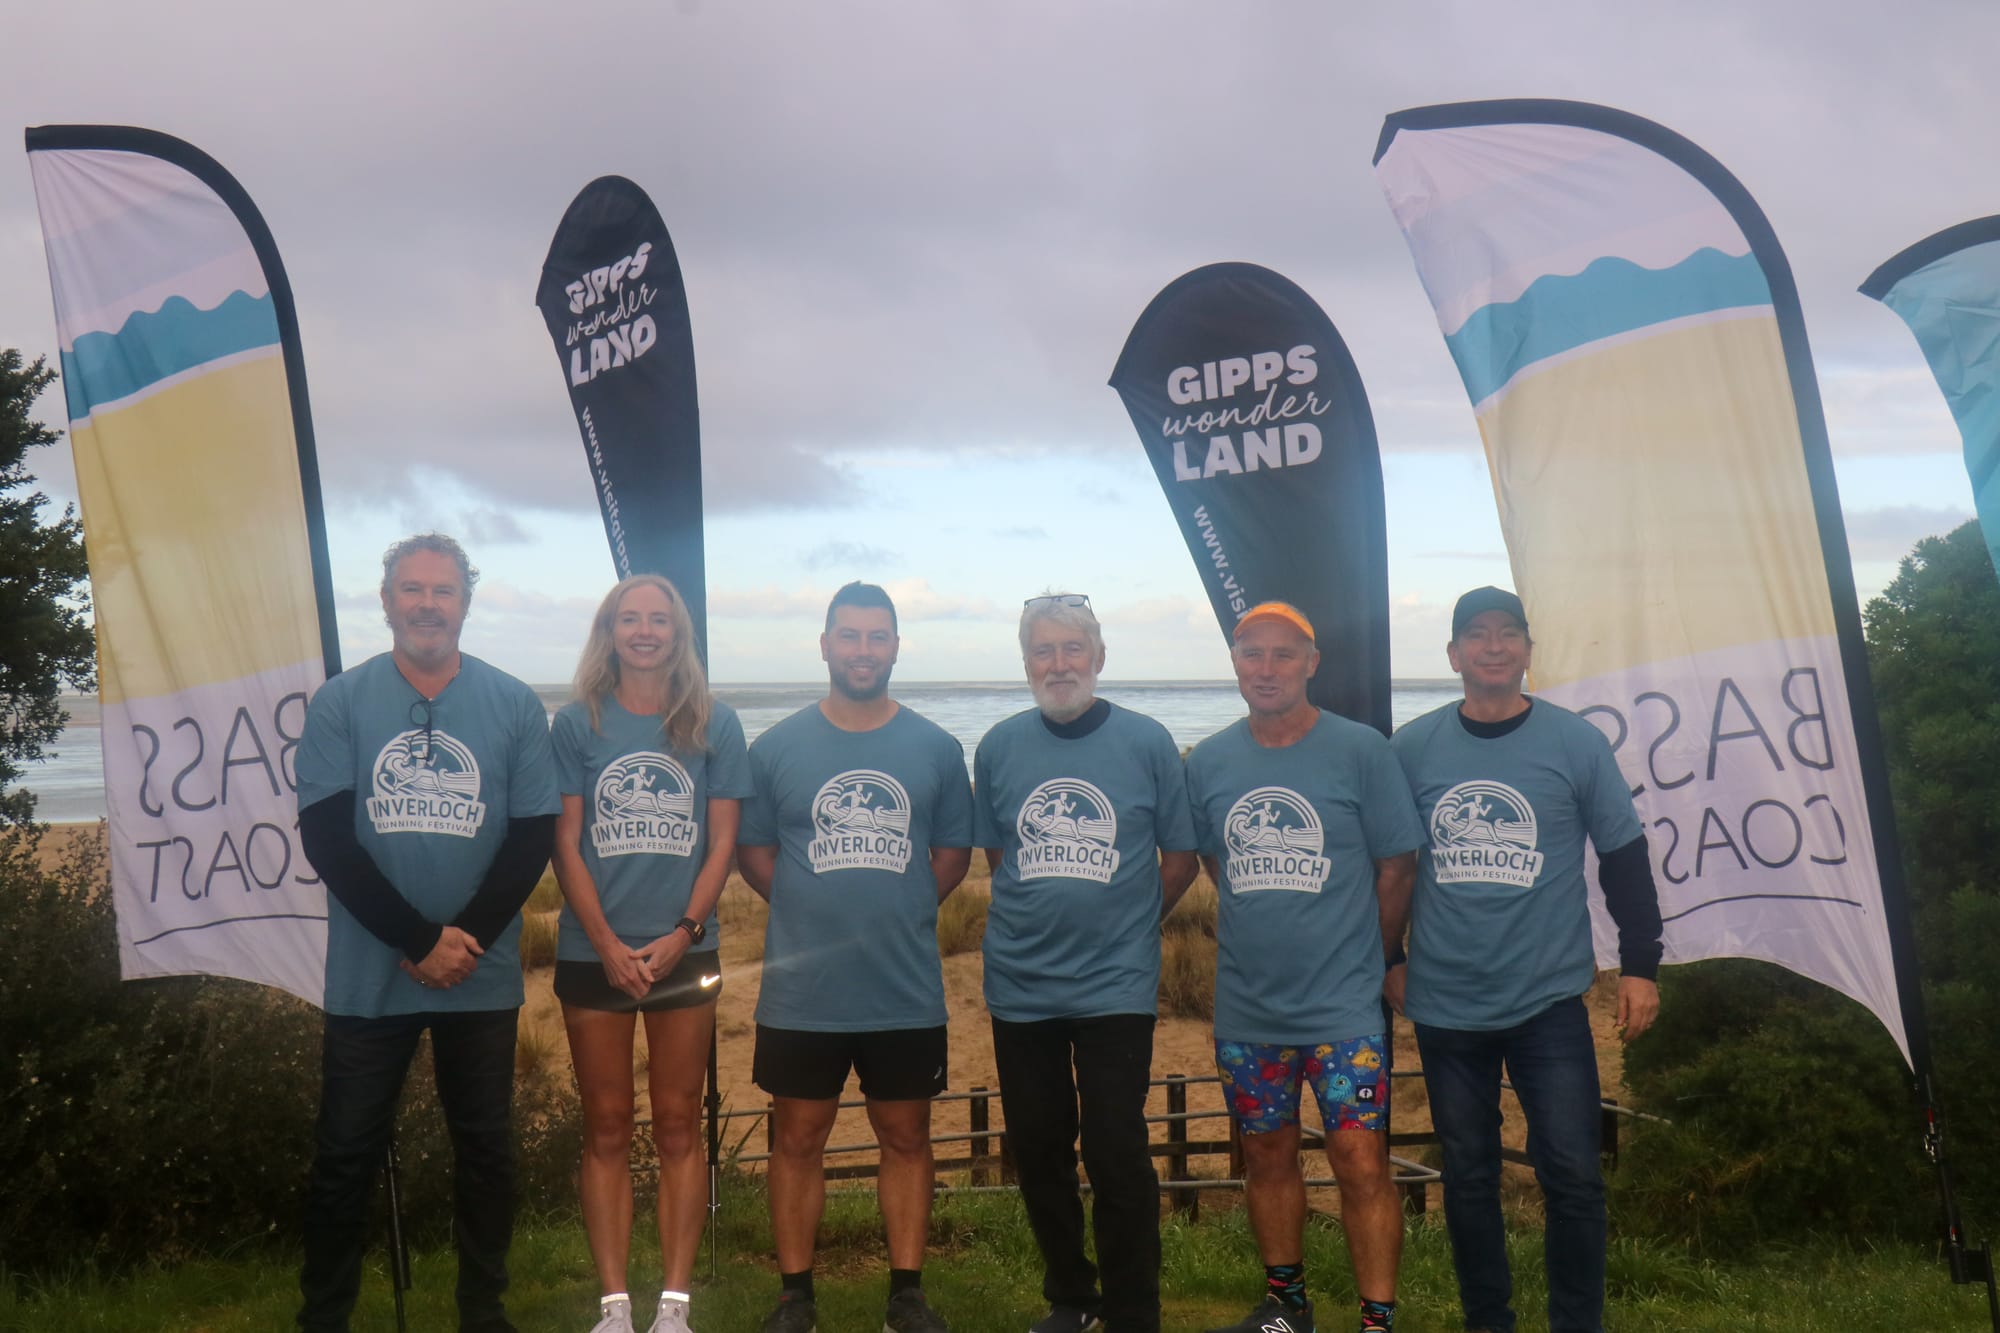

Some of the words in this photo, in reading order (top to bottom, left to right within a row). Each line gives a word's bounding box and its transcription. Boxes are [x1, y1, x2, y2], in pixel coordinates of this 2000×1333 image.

[565, 242, 652, 314] GIPPS
[566, 282, 657, 346] wonder
[571, 314, 657, 387] LAND
[1167, 344, 1318, 405] GIPPS
[1162, 383, 1331, 437] wonder
[1173, 422, 1322, 482] LAND
[373, 798, 479, 823] INVERLOCH
[377, 820, 423, 830] RUNNING
[428, 821, 473, 834] FESTIVAL
[595, 821, 693, 842] INVERLOCH
[600, 842, 643, 854] RUNNING
[647, 842, 689, 853] FESTIVAL
[813, 836, 908, 859] INVERLOCH
[1021, 845, 1113, 869] INVERLOCH
[816, 857, 859, 869] RUNNING
[863, 857, 904, 870] FESTIVAL
[1022, 866, 1060, 876] RUNNING
[1064, 866, 1108, 879] FESTIVAL
[1229, 857, 1324, 879] INVERLOCH
[1274, 878, 1319, 889] FESTIVAL
[1483, 870, 1530, 884] FESTIVAL
